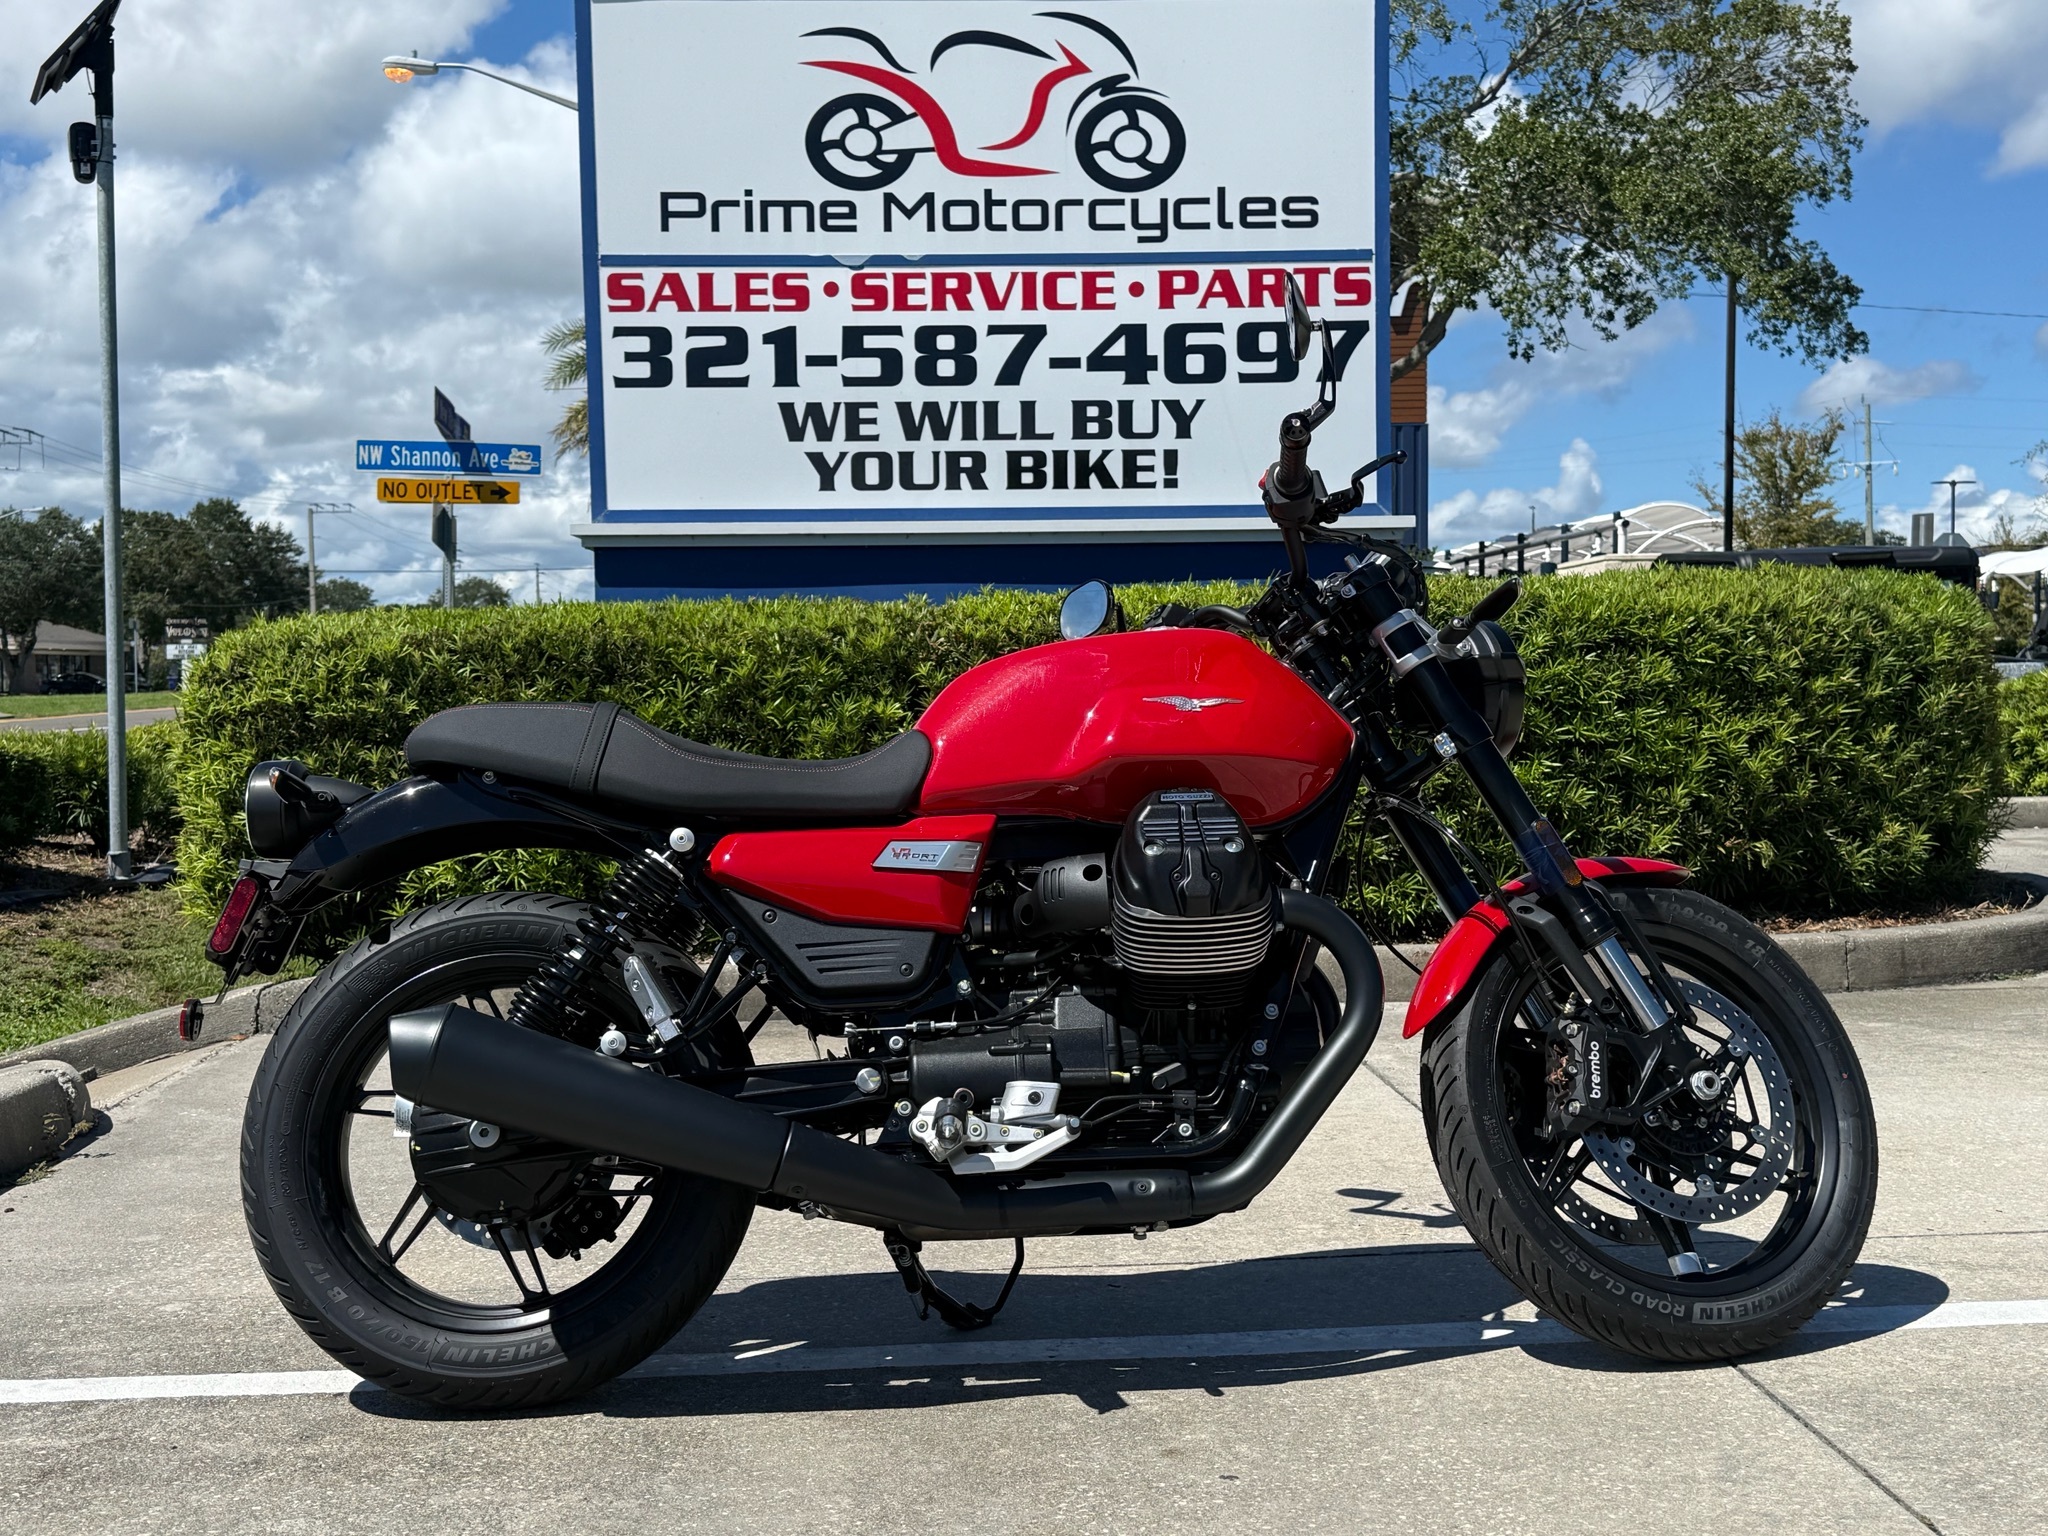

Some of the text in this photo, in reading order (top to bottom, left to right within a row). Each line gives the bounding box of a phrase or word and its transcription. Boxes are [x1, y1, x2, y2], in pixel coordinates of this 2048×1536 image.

[660, 186, 1319, 243] Prime Motorcycles
[607, 267, 1371, 312] SALES SERVICE PARTS
[612, 321, 1370, 388] 321-587-4697
[778, 399, 1206, 442] WE WILL BUY
[358, 444, 499, 469] NW Shannon Ave
[804, 449, 1179, 492] YOUR BIKE!
[383, 481, 484, 500] NO OUTLET
[402, 924, 549, 959] MICHELIN
[1588, 1041, 1602, 1099] brembo
[304, 1260, 332, 1285] 17
[1549, 1236, 1799, 1321] MICHELIN ROAD CLASSIC
[443, 1331, 576, 1364] CHELIN
